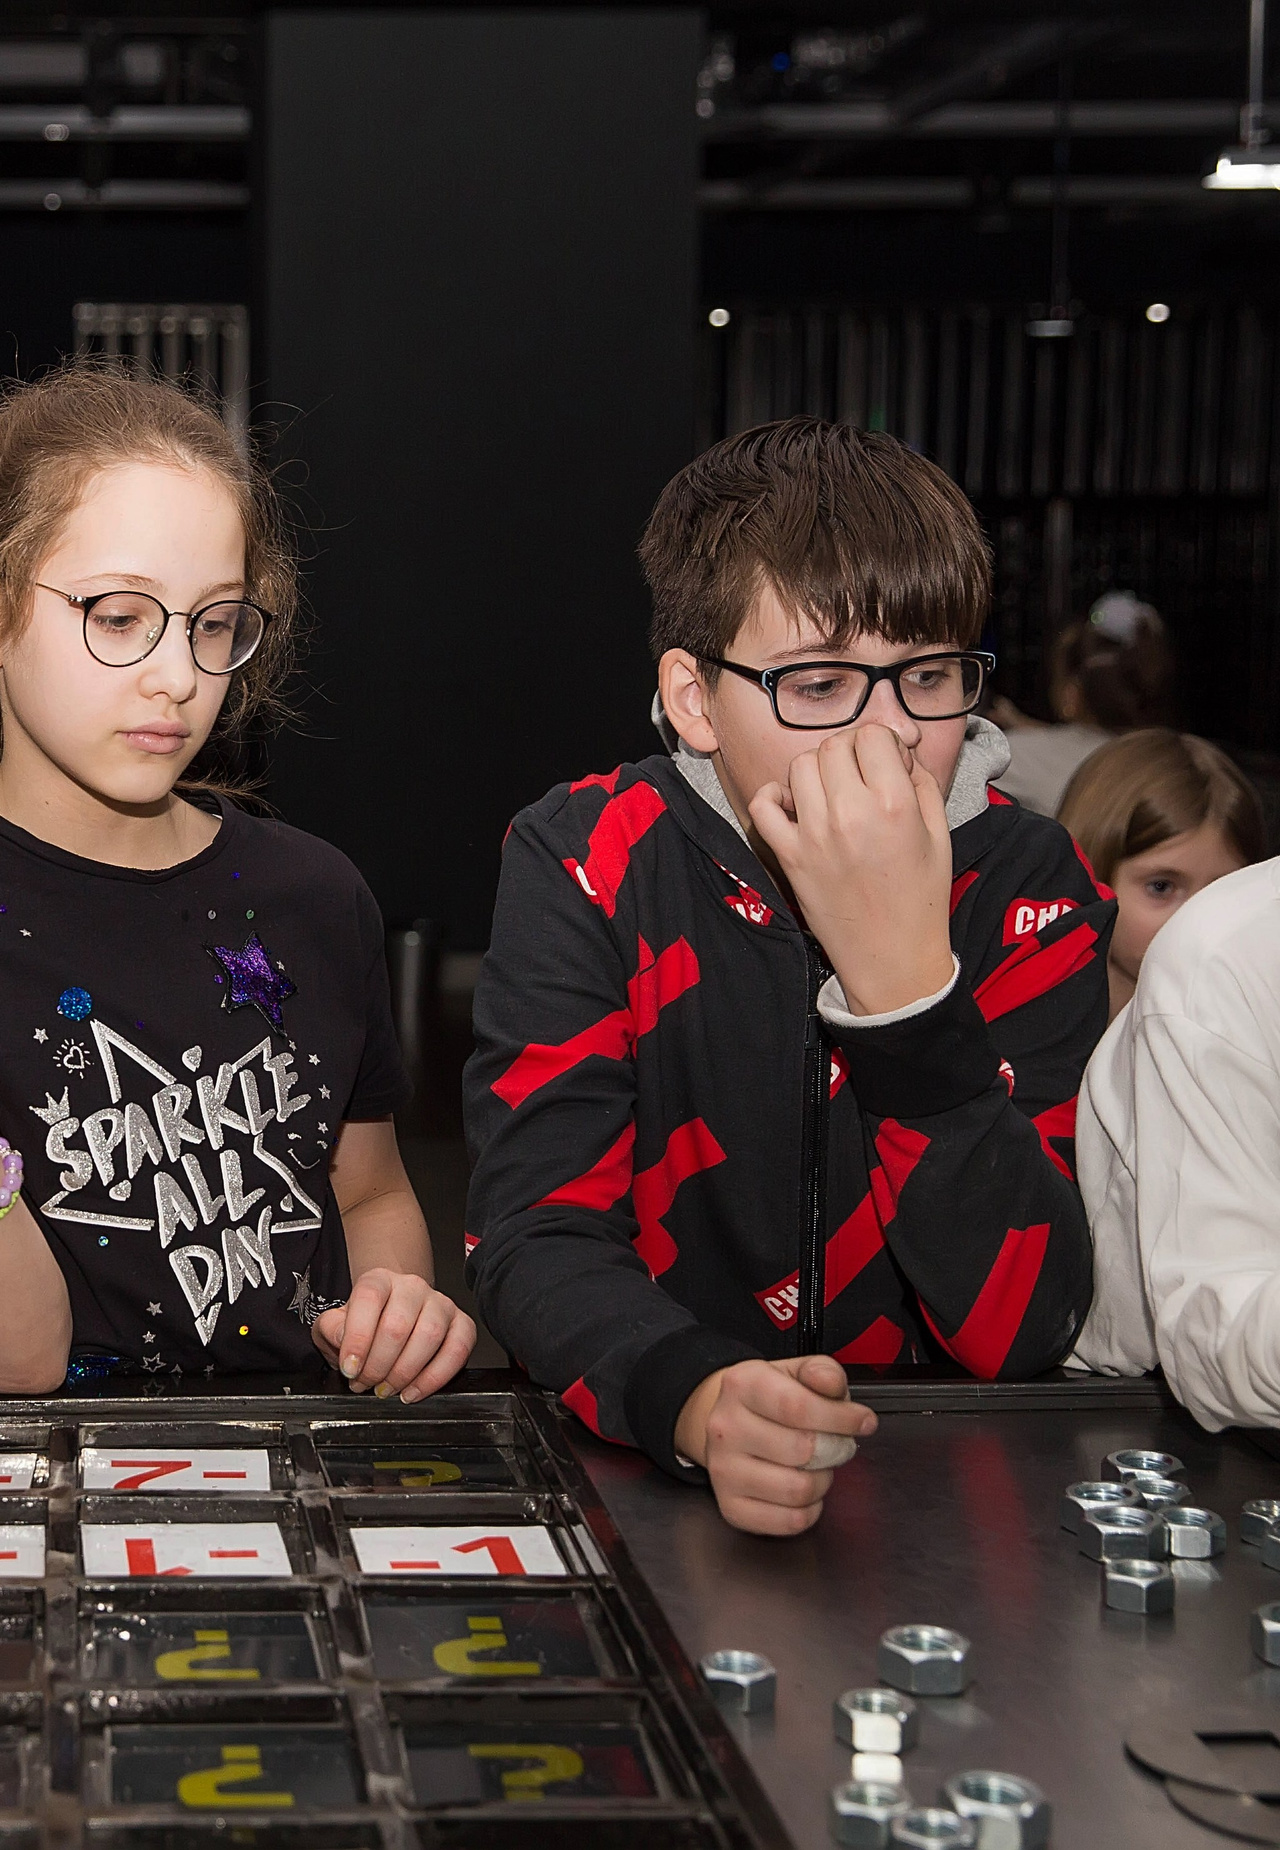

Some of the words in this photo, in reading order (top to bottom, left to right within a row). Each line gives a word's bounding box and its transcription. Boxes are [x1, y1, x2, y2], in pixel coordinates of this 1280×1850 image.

[45, 1052, 313, 1192] SPARKLE
[154, 1149, 266, 1249] ALL
[169, 1205, 277, 1318] DAY
